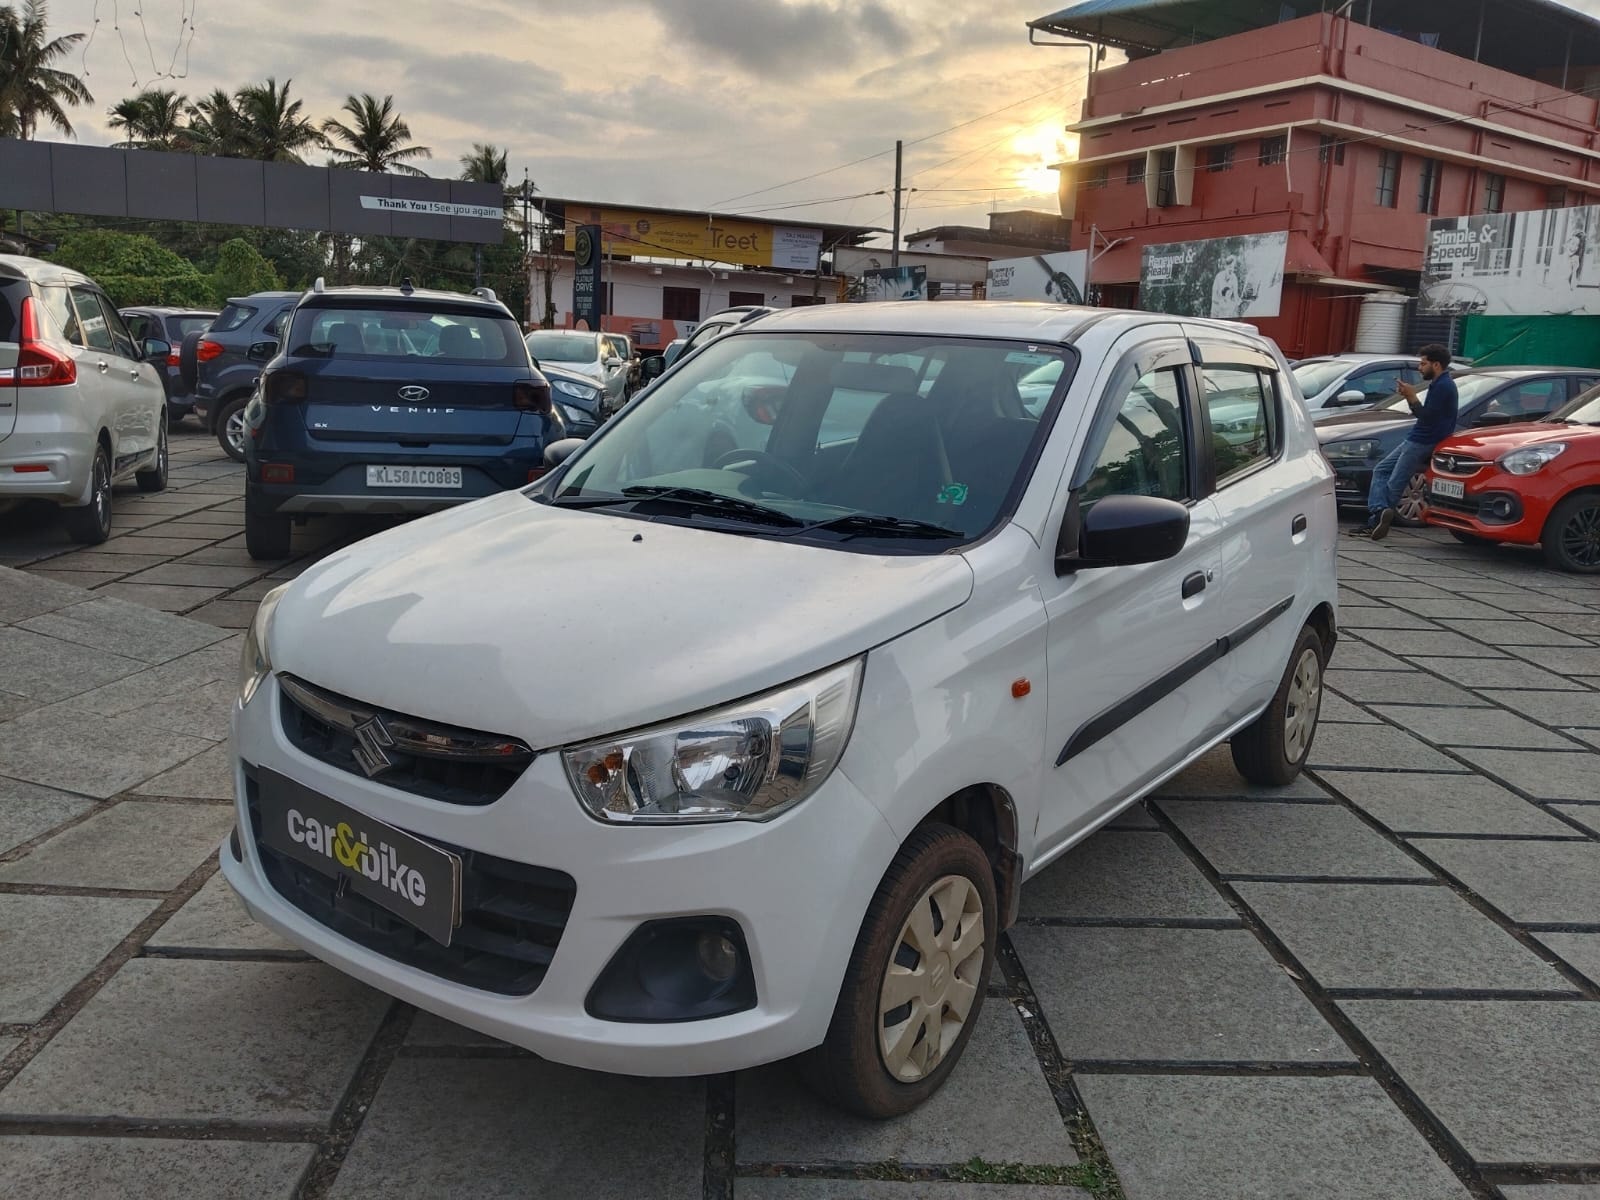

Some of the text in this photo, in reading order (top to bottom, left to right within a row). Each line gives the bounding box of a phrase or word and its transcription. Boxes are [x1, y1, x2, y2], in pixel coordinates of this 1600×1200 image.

[377, 198, 407, 209] Thank
[409, 201, 427, 211] You
[434, 203, 451, 213] See
[453, 206, 470, 216] you
[472, 207, 497, 218] again
[705, 226, 759, 252] Treet
[1432, 223, 1498, 244] Simple &
[1148, 248, 1196, 267] Renewed &
[1431, 243, 1479, 262] Speedy
[1148, 265, 1171, 279] Ready
[575, 282, 593, 292] DRIVE
[287, 808, 427, 908] car&bike
